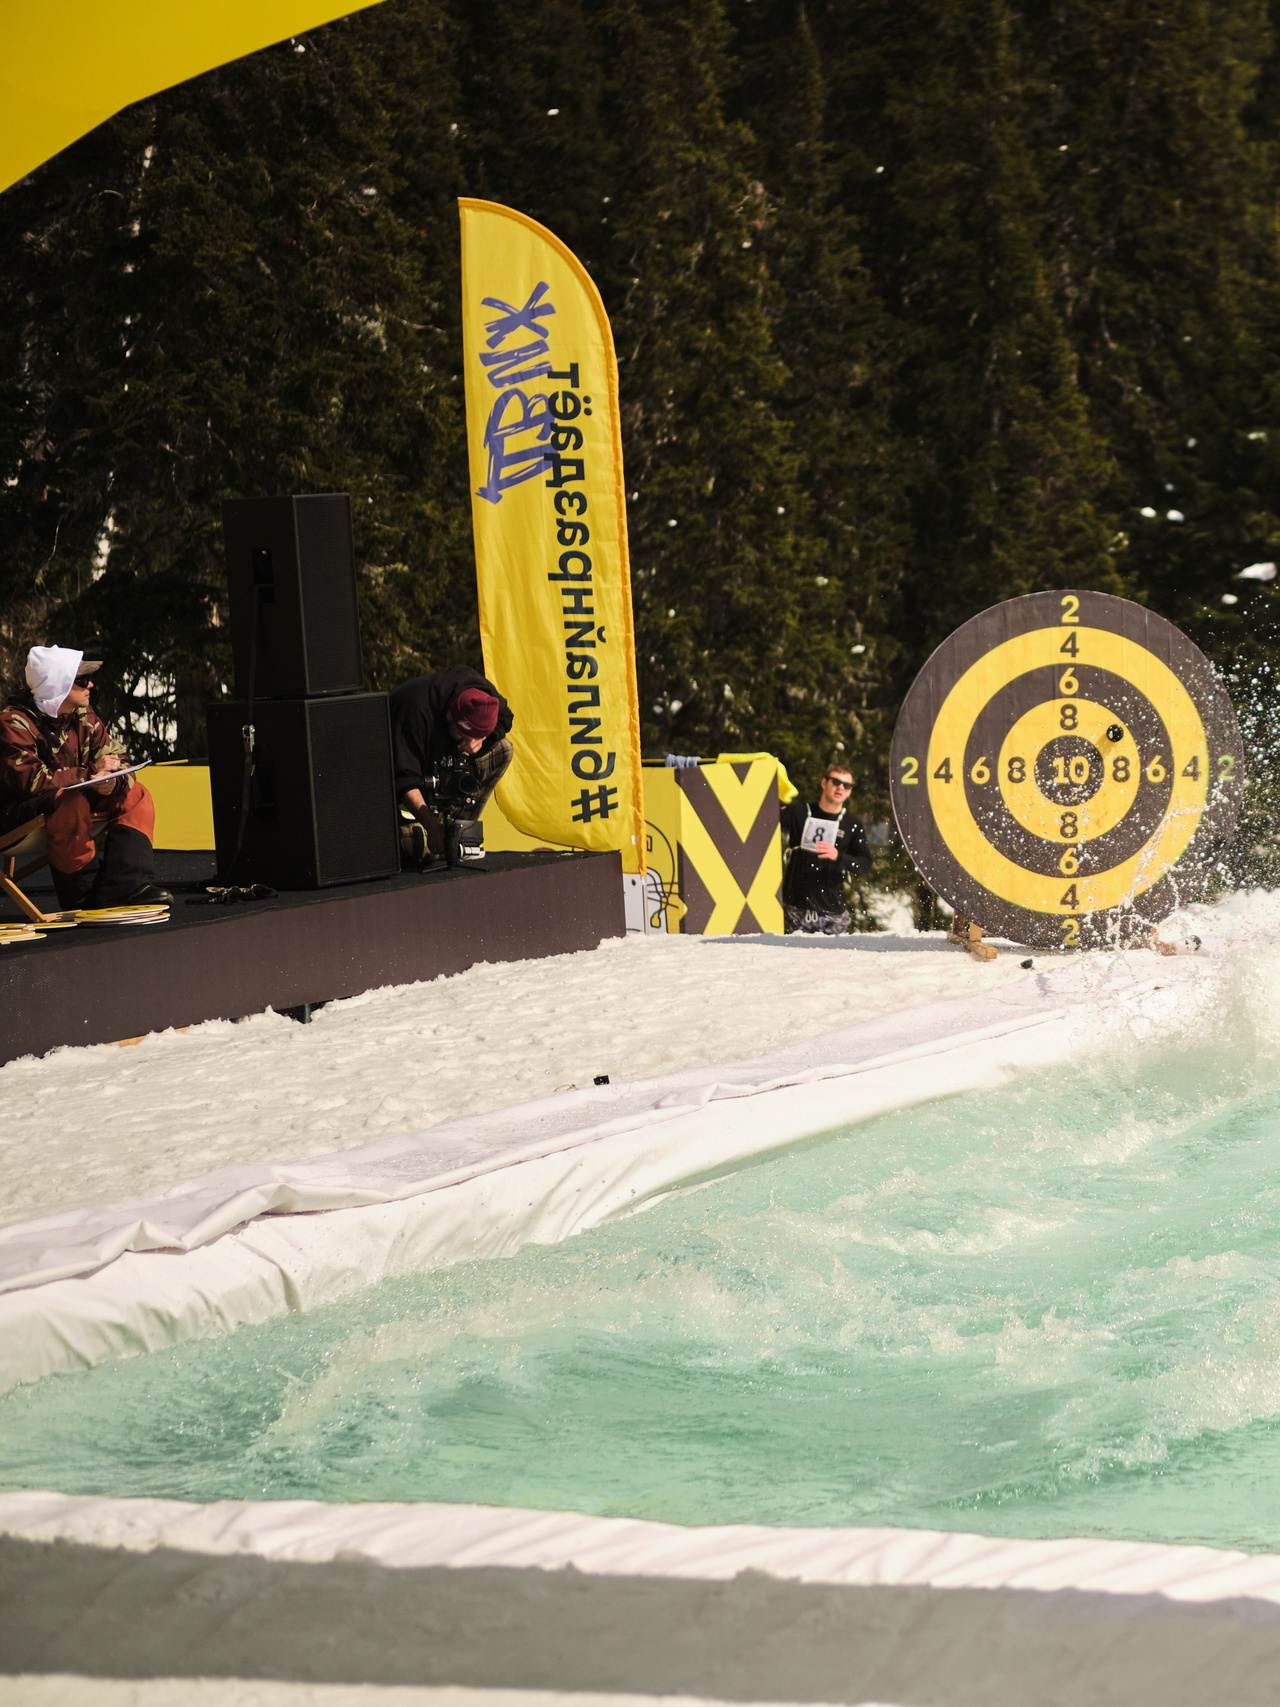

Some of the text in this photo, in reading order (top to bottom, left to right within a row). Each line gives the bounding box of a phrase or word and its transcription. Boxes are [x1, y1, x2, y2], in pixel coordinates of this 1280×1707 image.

[1060, 595, 1079, 623] 2
[1060, 631, 1079, 657] 4
[1059, 668, 1079, 695] 6
[1060, 704, 1078, 730] 8
[901, 755, 1235, 784] 2 4 6 8 10 8 6 4 2
[812, 827, 825, 844] 8
[1060, 811, 1078, 838] 8
[1059, 848, 1078, 875] 6
[1060, 884, 1079, 910] 4
[1060, 919, 1079, 945] 2
